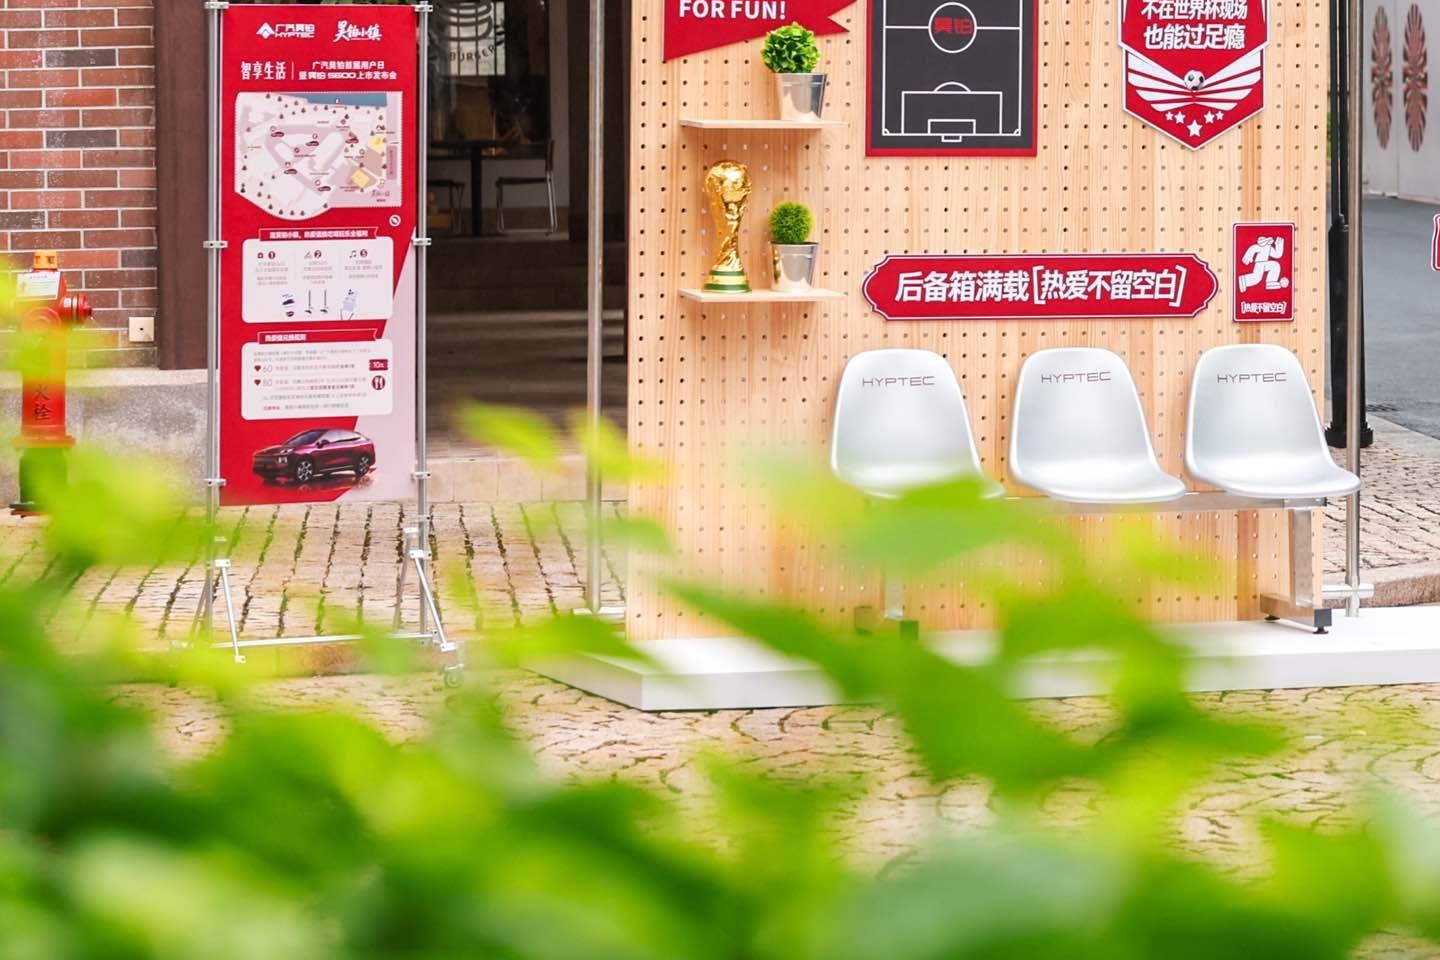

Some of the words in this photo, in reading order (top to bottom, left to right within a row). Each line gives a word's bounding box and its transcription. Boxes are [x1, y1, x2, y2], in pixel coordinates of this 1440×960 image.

[679, 0, 725, 18] FOR
[730, 0, 786, 20] FUN!
[1143, 23, 1246, 50] 也能过足瘾
[861, 375, 936, 387] HYPTEC
[1040, 370, 1112, 383] HYPTEC
[1216, 371, 1288, 383] HYPTEC
